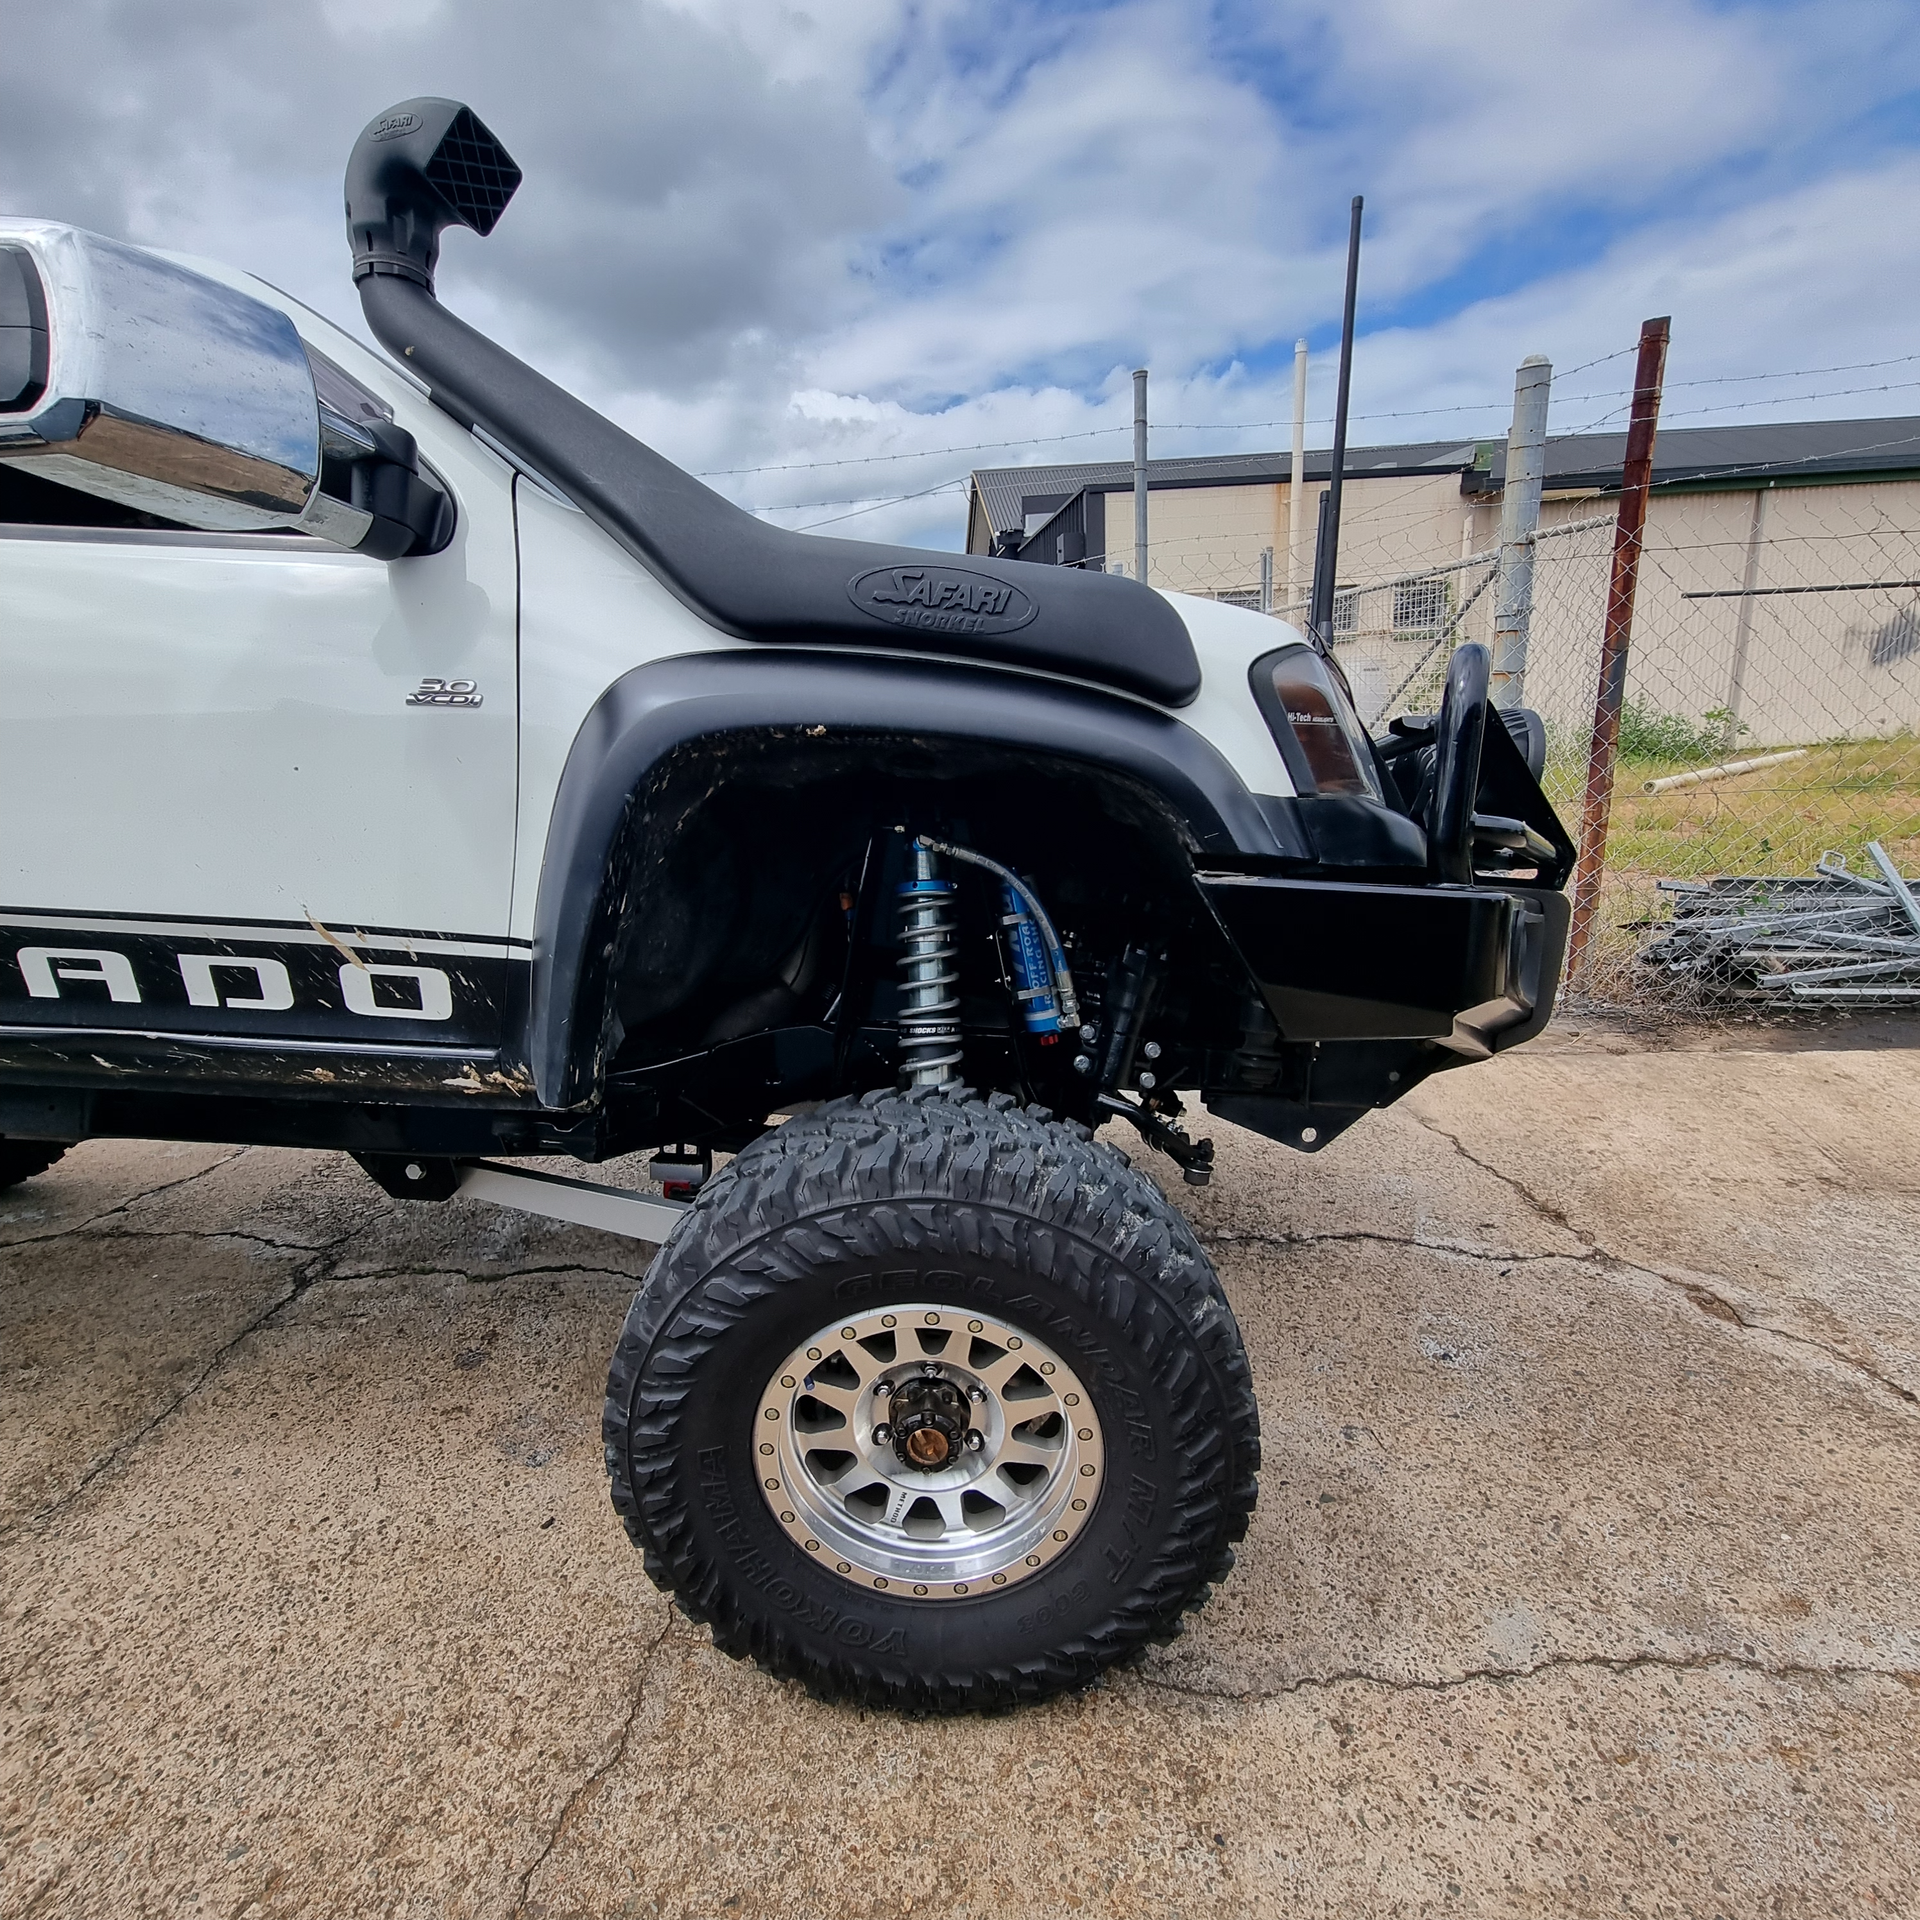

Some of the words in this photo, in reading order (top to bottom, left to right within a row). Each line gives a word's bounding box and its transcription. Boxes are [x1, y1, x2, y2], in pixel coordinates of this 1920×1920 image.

[373, 115, 414, 135] SAFARI
[872, 569, 1013, 615] SAFARI
[894, 609, 986, 633] SNORKEL
[1287, 711, 1312, 723] Hi-Tech
[1021, 919, 1040, 990] OFF-ROA
[1034, 948, 1051, 1006] RCING
[16, 945, 454, 1021] ADO
[909, 1026, 937, 1035] SHOCKS
[833, 1268, 1157, 1463] GEOLANDAR
[890, 1491, 908, 1524] METHOD
[696, 1445, 909, 1657] YOKOHAMA
